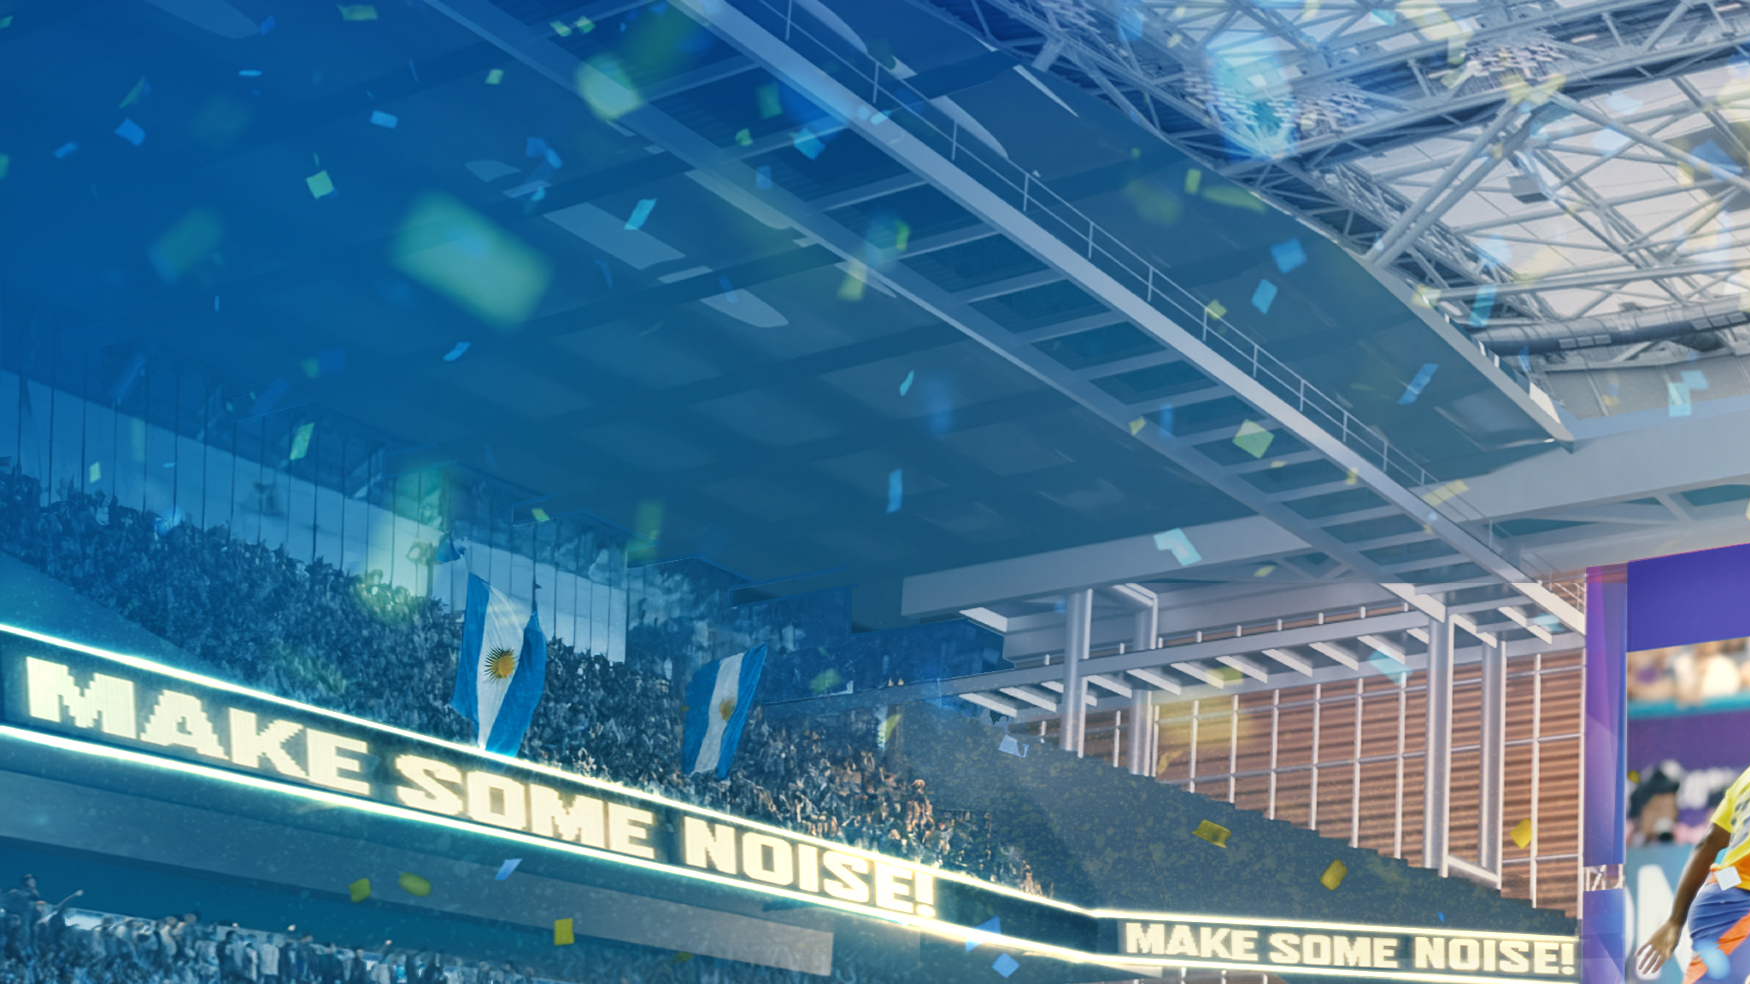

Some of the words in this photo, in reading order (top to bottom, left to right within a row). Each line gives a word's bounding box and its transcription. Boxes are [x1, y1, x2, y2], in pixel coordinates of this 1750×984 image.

[27, 656, 370, 795] MAKE
[395, 754, 655, 860] SOME
[684, 815, 936, 918] NOISE!
[1126, 922, 1258, 961] MAKE
[1269, 933, 1398, 969] SOME
[1415, 937, 1575, 975] NOISE!
